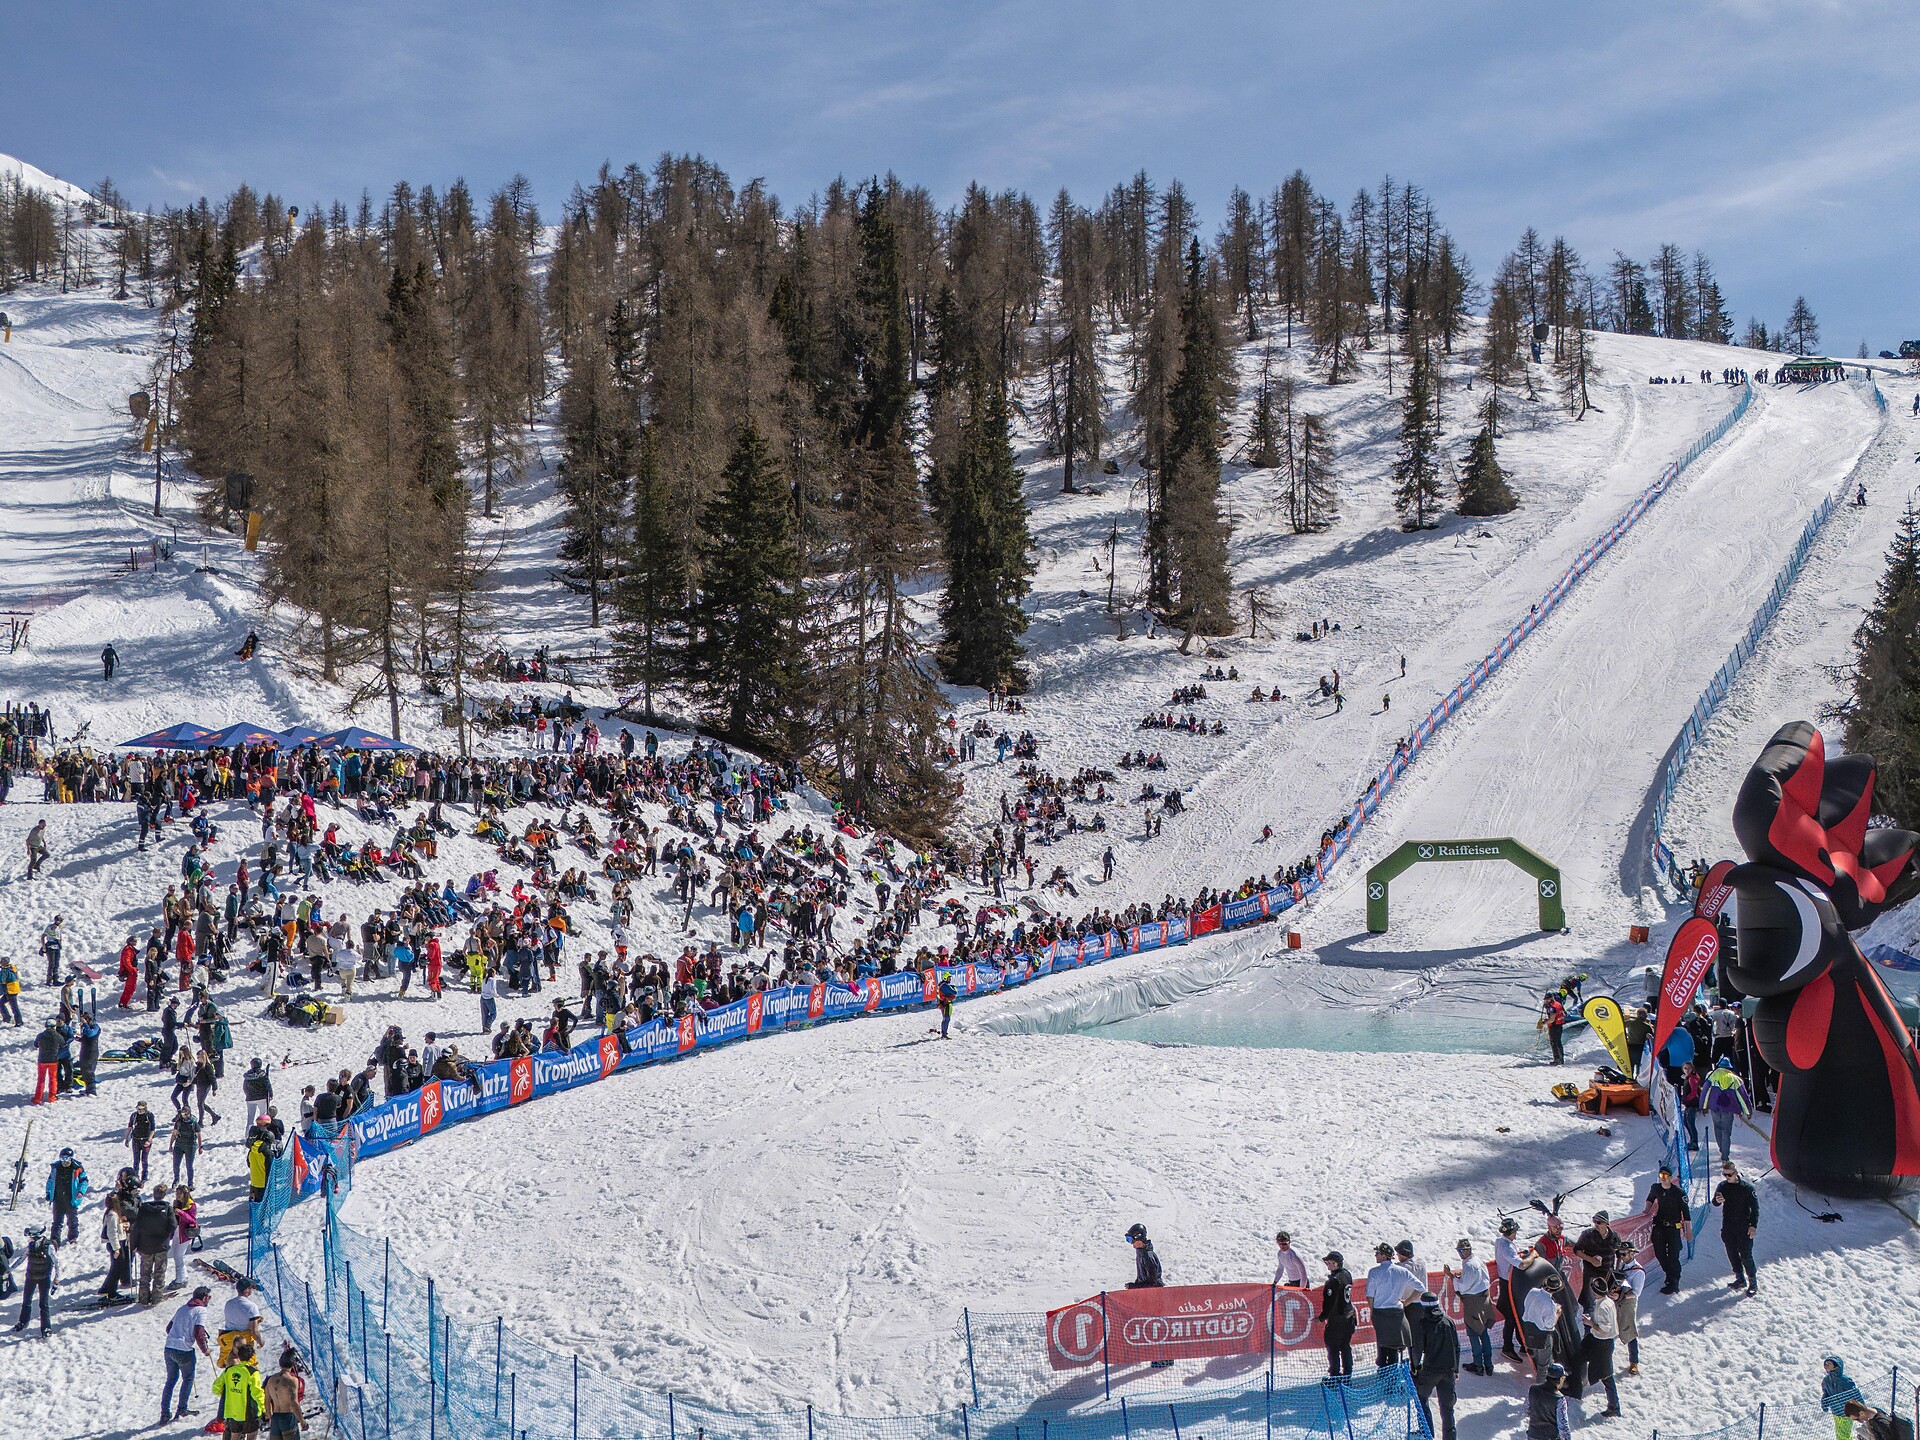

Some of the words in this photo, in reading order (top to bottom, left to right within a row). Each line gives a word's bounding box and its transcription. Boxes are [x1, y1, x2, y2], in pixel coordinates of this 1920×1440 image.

[1438, 845, 1500, 856] Raiffeisen
[1225, 901, 1260, 919] Kronplatz
[881, 976, 922, 1000] Kronplatz
[1665, 978, 1678, 996] Mein
[1674, 957, 1689, 976] Radio
[762, 990, 808, 1016] Kronplatz
[535, 1053, 600, 1085] Kronplatz
